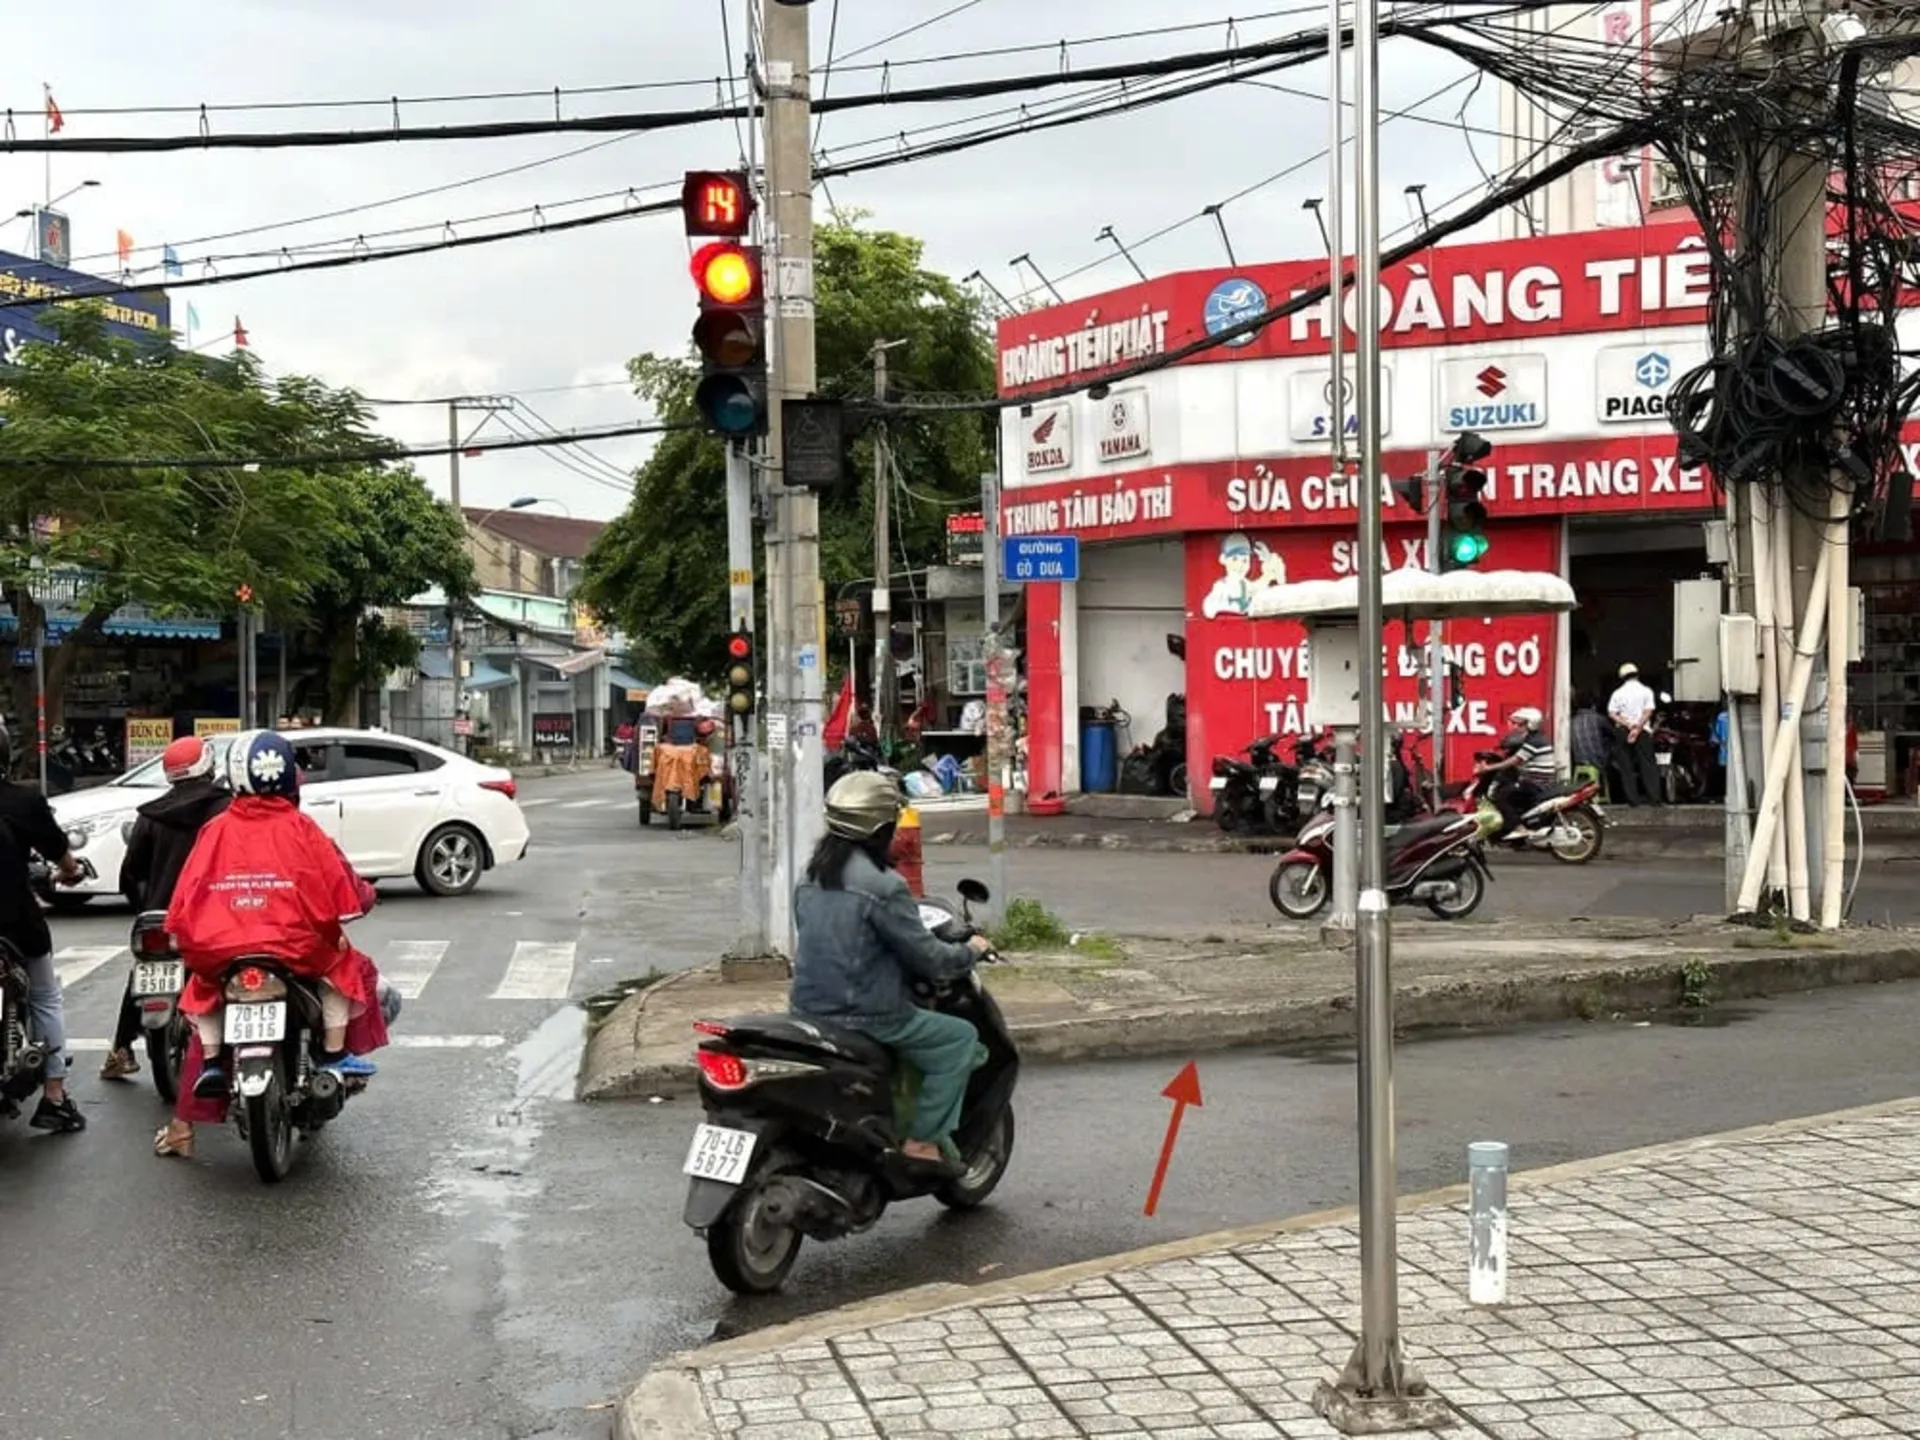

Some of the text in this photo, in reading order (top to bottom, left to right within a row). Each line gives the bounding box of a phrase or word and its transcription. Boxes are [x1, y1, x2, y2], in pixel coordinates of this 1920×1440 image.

[708, 187, 735, 221] 14
[1002, 334, 1066, 388] HOÀNG
[1450, 402, 1536, 427] SUZUKI
[1027, 448, 1064, 468] HONDA
[1100, 434, 1141, 456] YAMAHA
[1508, 459, 1639, 499] TRANG
[1651, 456, 1704, 493] XE
[1004, 501, 1059, 535] TRUNG
[1062, 489, 1098, 528] TÂM
[1215, 639, 1312, 679] CHUYÊ
[693, 1151, 739, 1178] 5877
